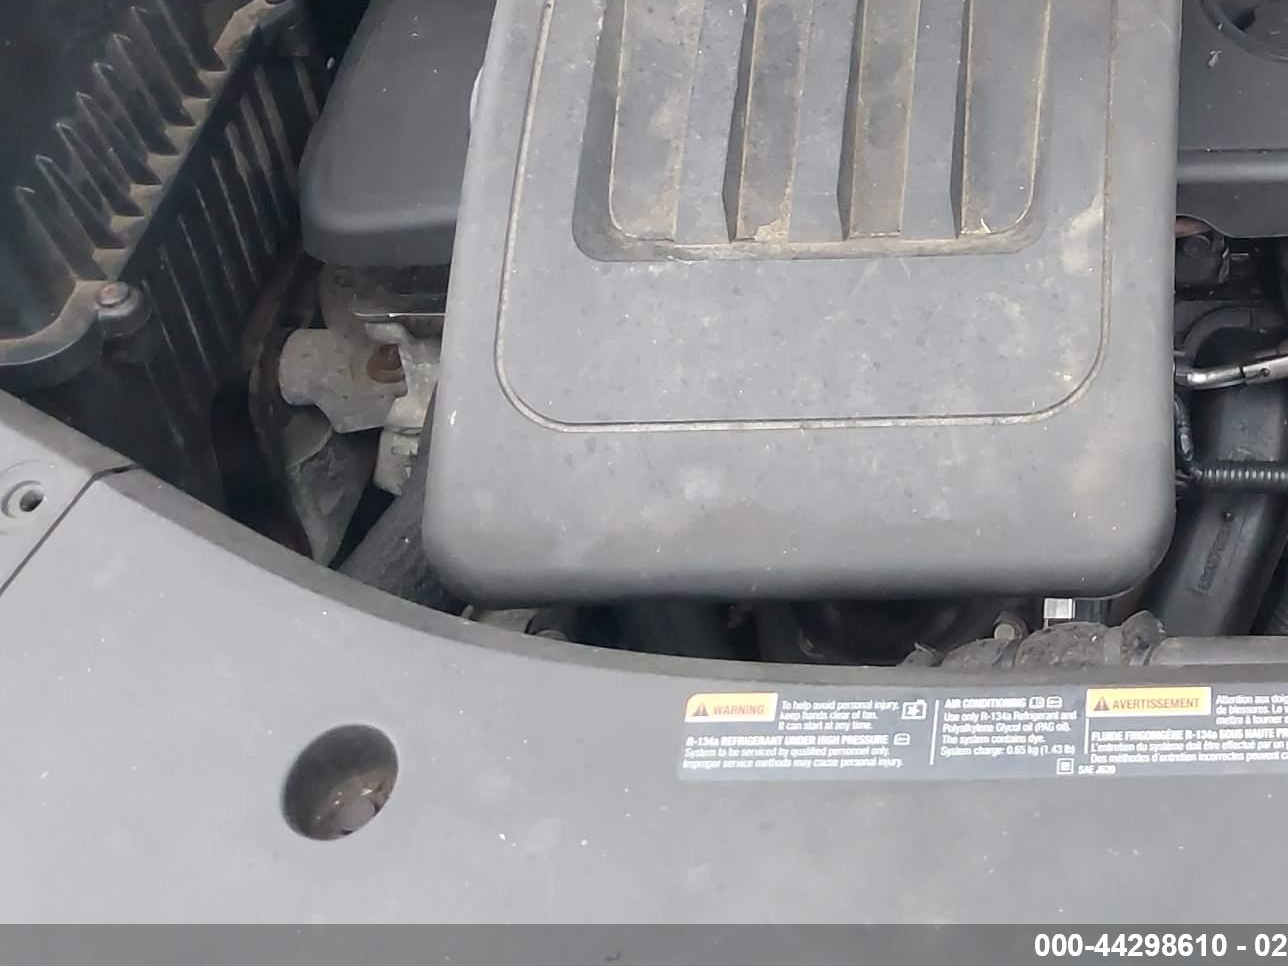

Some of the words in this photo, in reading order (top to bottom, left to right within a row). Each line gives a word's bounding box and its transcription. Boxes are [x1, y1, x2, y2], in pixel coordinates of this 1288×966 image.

[945, 699, 961, 708] AIR
[963, 698, 1026, 708] CONDITIONING
[1113, 698, 1200, 709] AVERTISSEMENT
[1216, 695, 1253, 704] Attention
[714, 705, 764, 714] WARNING
[782, 700, 791, 709] To
[793, 700, 811, 711] help
[813, 700, 836, 709] avoid
[837, 700, 873, 710] personal
[874, 700, 899, 711] injury.
[1216, 706, 1227, 714] de
[1229, 706, 1270, 714] blessures.
[1272, 705, 1282, 713] Le
[779, 711, 800, 720] keep
[802, 711, 827, 719] hands
[829, 711, 850, 719] clear
[852, 711, 860, 719] of
[862, 711, 878, 719] fan.
[944, 712, 960, 721] Use
[962, 712, 979, 722] only
[981, 712, 1011, 720] R-134a
[1013, 711, 1058, 721] Refrigerant
[1061, 711, 1077, 719] and
[1216, 716, 1243, 724] mettre
[1253, 715, 1282, 723] tourner
[778, 721, 784, 730] It
[786, 722, 801, 730] can
[804, 722, 822, 730] start
[824, 721, 833, 729] at
[835, 722, 850, 731] any
[852, 721, 873, 729] time.
[943, 724, 994, 734] Polyalkylene
[996, 723, 1021, 733] Glycol
[1023, 723, 1033, 732] oil
[1035, 722, 1054, 732] (PAG
[686, 736, 719, 746] R-134a
[721, 736, 782, 746] REFRIGERANT
[784, 735, 816, 745] UNDER
[817, 735, 840, 744] HIGH
[841, 735, 889, 744] PRESSURE
[943, 735, 957, 744] The
[960, 735, 989, 745] system
[991, 734, 1026, 743] contains
[1028, 734, 1045, 744] dye.
[1091, 731, 1123, 741] FLUIDE
[1185, 730, 1218, 739] R-134a
[1219, 729, 1243, 739] SOUS
[1245, 729, 1274, 738] HAUTE
[941, 746, 971, 756] System
[1028, 745, 1039, 756] kg
[1064, 745, 1075, 754] lb)
[1136, 743, 1147, 751] du
[1185, 741, 1201, 750] doit
[1257, 742, 1271, 750] par
[685, 748, 716, 758] System
[718, 748, 726, 757] to
[728, 748, 739, 756] be
[741, 748, 776, 756] serviced
[779, 748, 788, 757] by
[791, 747, 826, 757] qualified
[829, 746, 869, 756] personnel
[871, 746, 889, 756] only.
[1091, 754, 1107, 763] Des
[1246, 752, 1279, 762] peuvent
[683, 760, 720, 769] Improper
[755, 759, 791, 767] methods
[793, 759, 811, 768] may
[840, 758, 876, 767] personal
[879, 758, 903, 768] injury.
[1079, 765, 1095, 774] SAE
